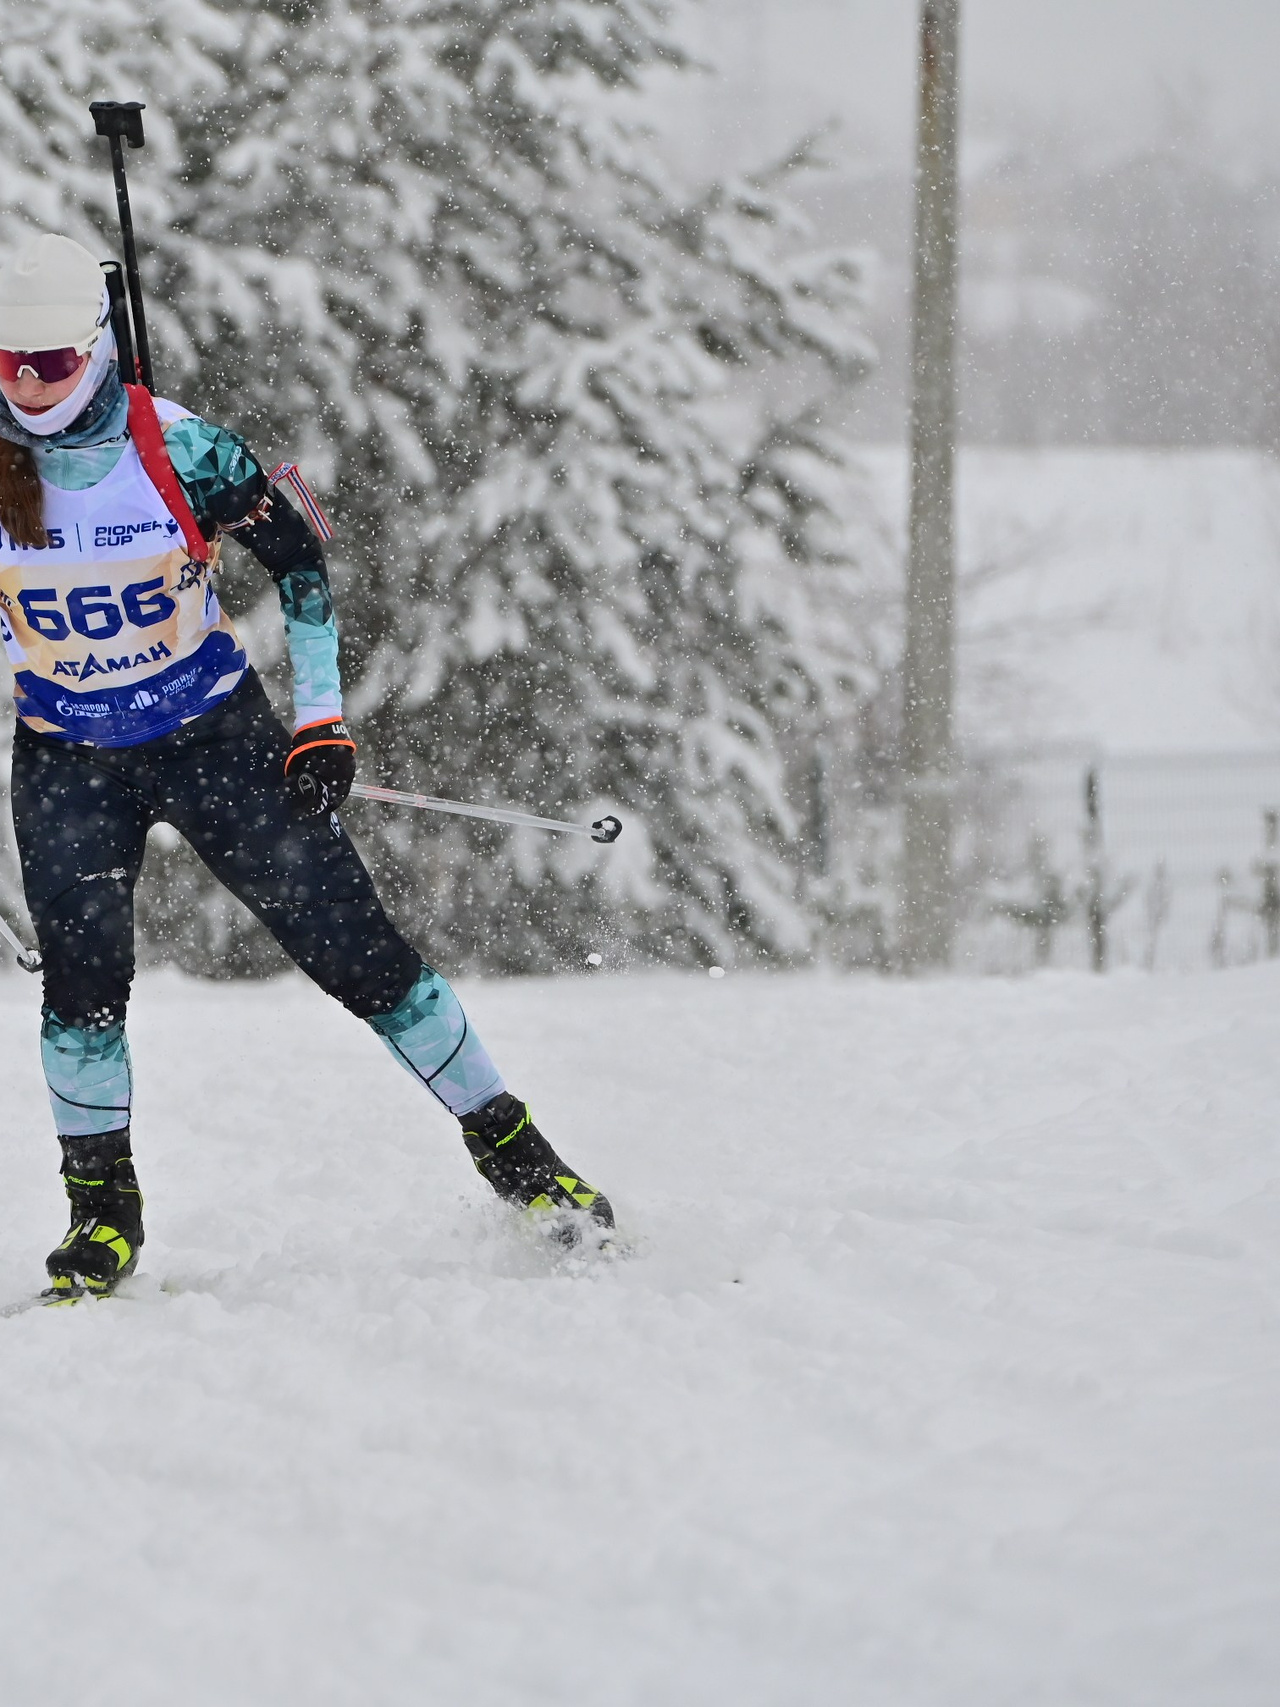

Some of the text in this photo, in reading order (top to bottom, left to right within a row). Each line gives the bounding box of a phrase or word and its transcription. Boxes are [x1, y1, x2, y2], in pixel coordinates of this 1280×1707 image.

[95, 520, 162, 536] PIONER
[94, 535, 133, 547] CUP
[17, 576, 176, 641] 666
[52, 641, 172, 682] АТАМАН
[67, 1175, 105, 1186] FISCHER
